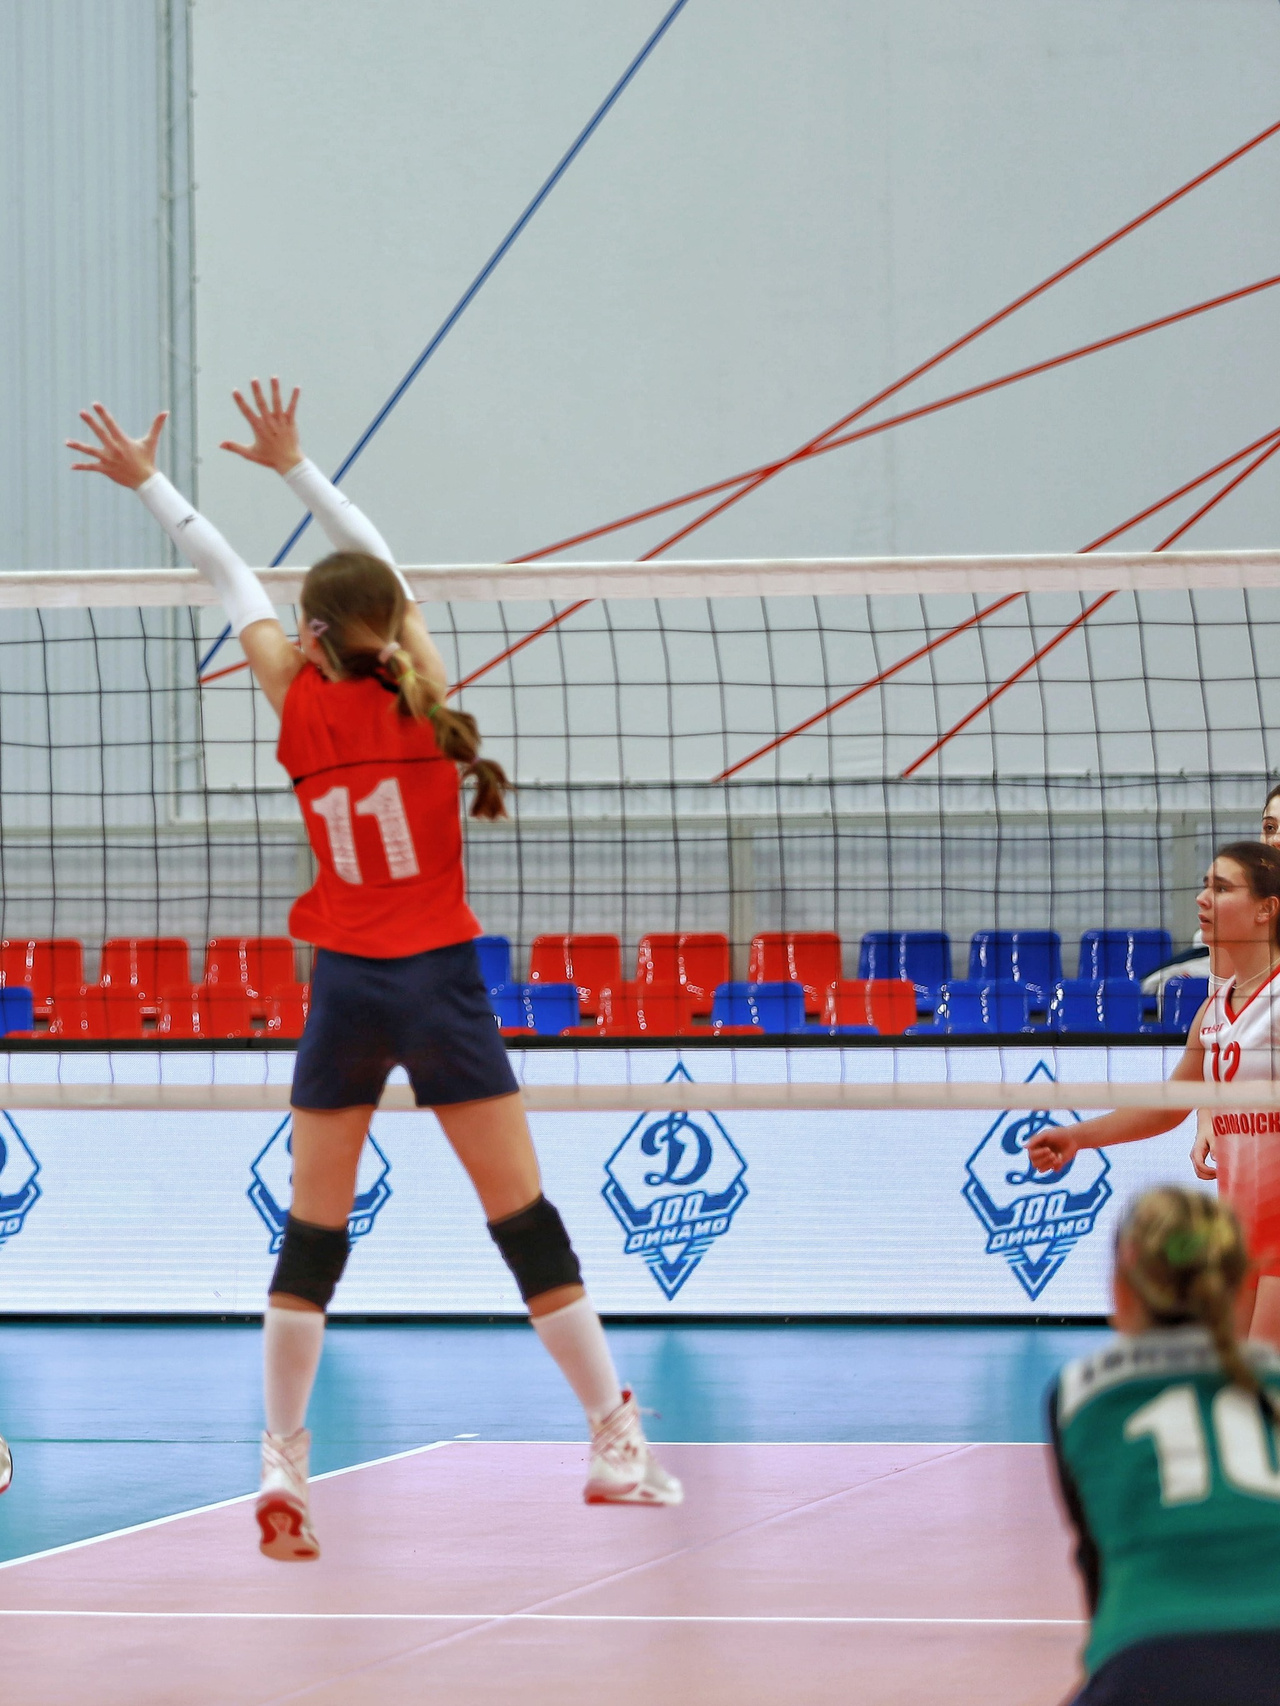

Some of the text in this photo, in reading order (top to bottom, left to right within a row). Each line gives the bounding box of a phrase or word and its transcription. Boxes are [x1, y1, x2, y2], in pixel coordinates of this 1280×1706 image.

[310, 777, 420, 886] 11
[1211, 1041, 1241, 1082] 12
[649, 1192, 705, 1229] 100
[1010, 1191, 1067, 1229] 100
